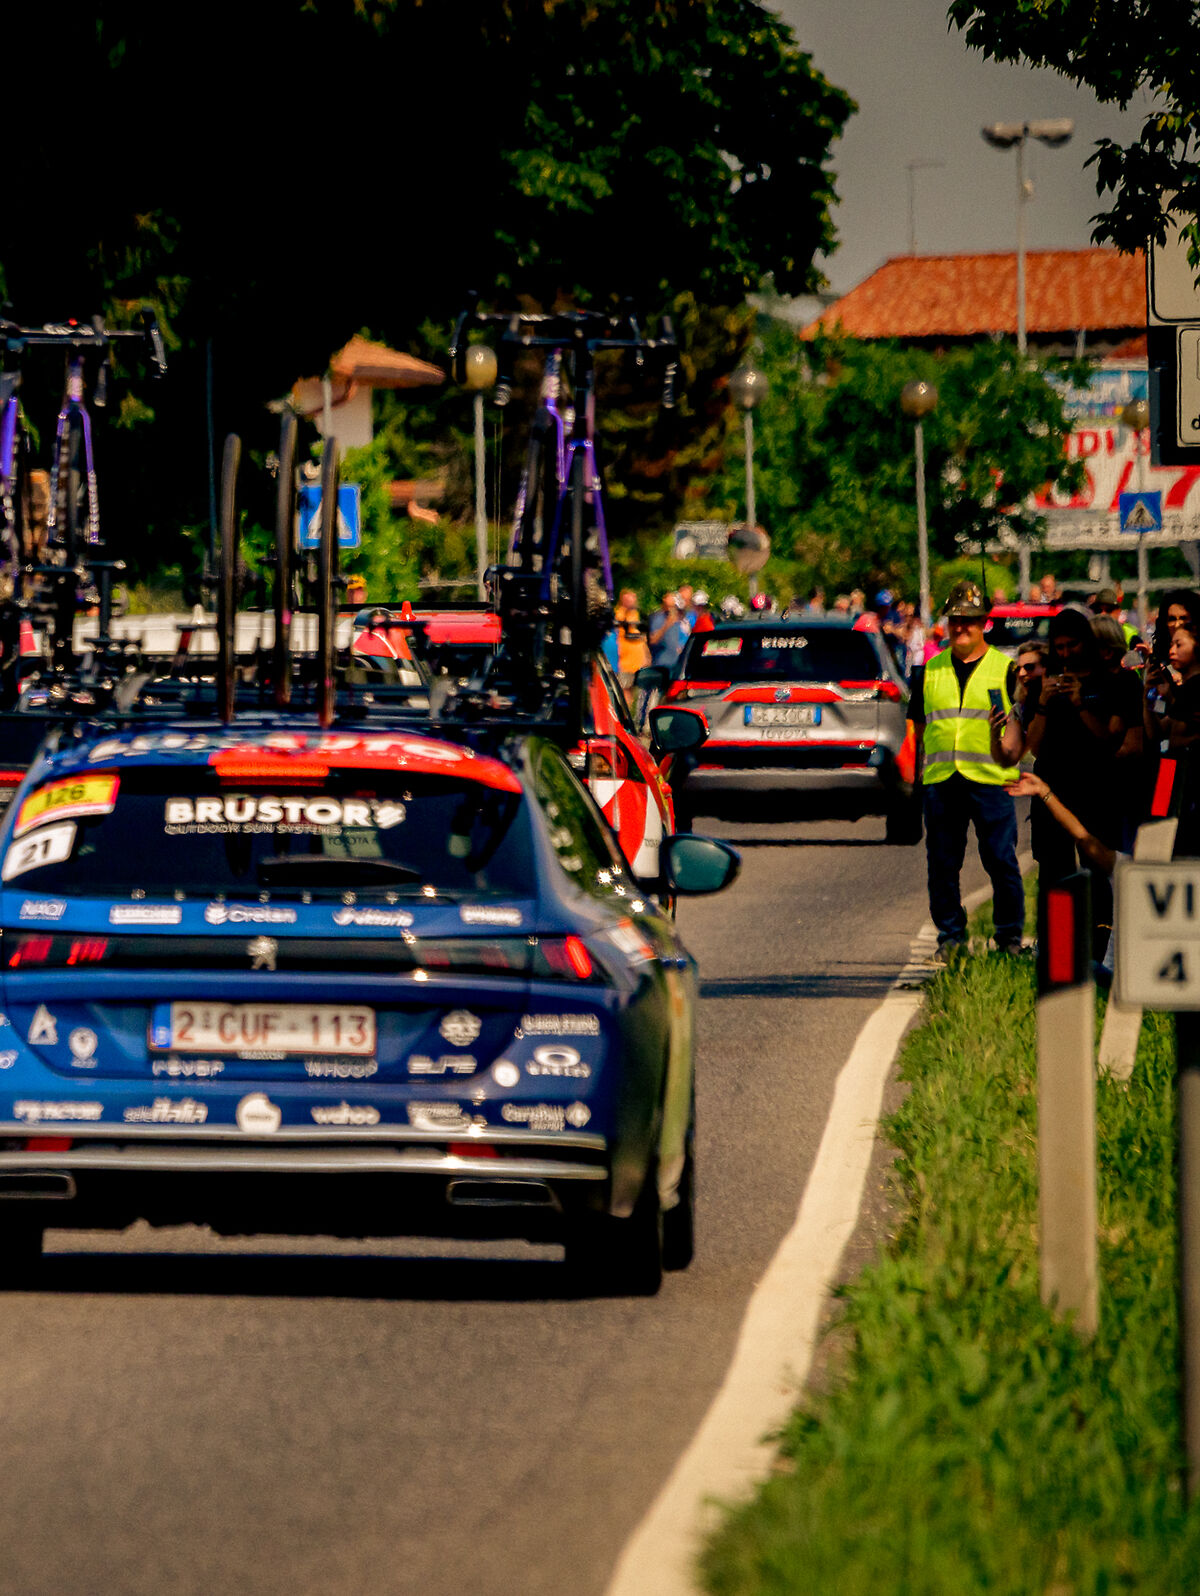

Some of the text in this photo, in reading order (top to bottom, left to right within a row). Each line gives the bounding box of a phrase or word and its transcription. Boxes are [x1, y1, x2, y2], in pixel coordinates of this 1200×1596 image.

[46, 784, 86, 806] 126
[164, 798, 373, 828] BRUSTOR
[17, 839, 52, 866] 21
[1158, 951, 1189, 985] 4
